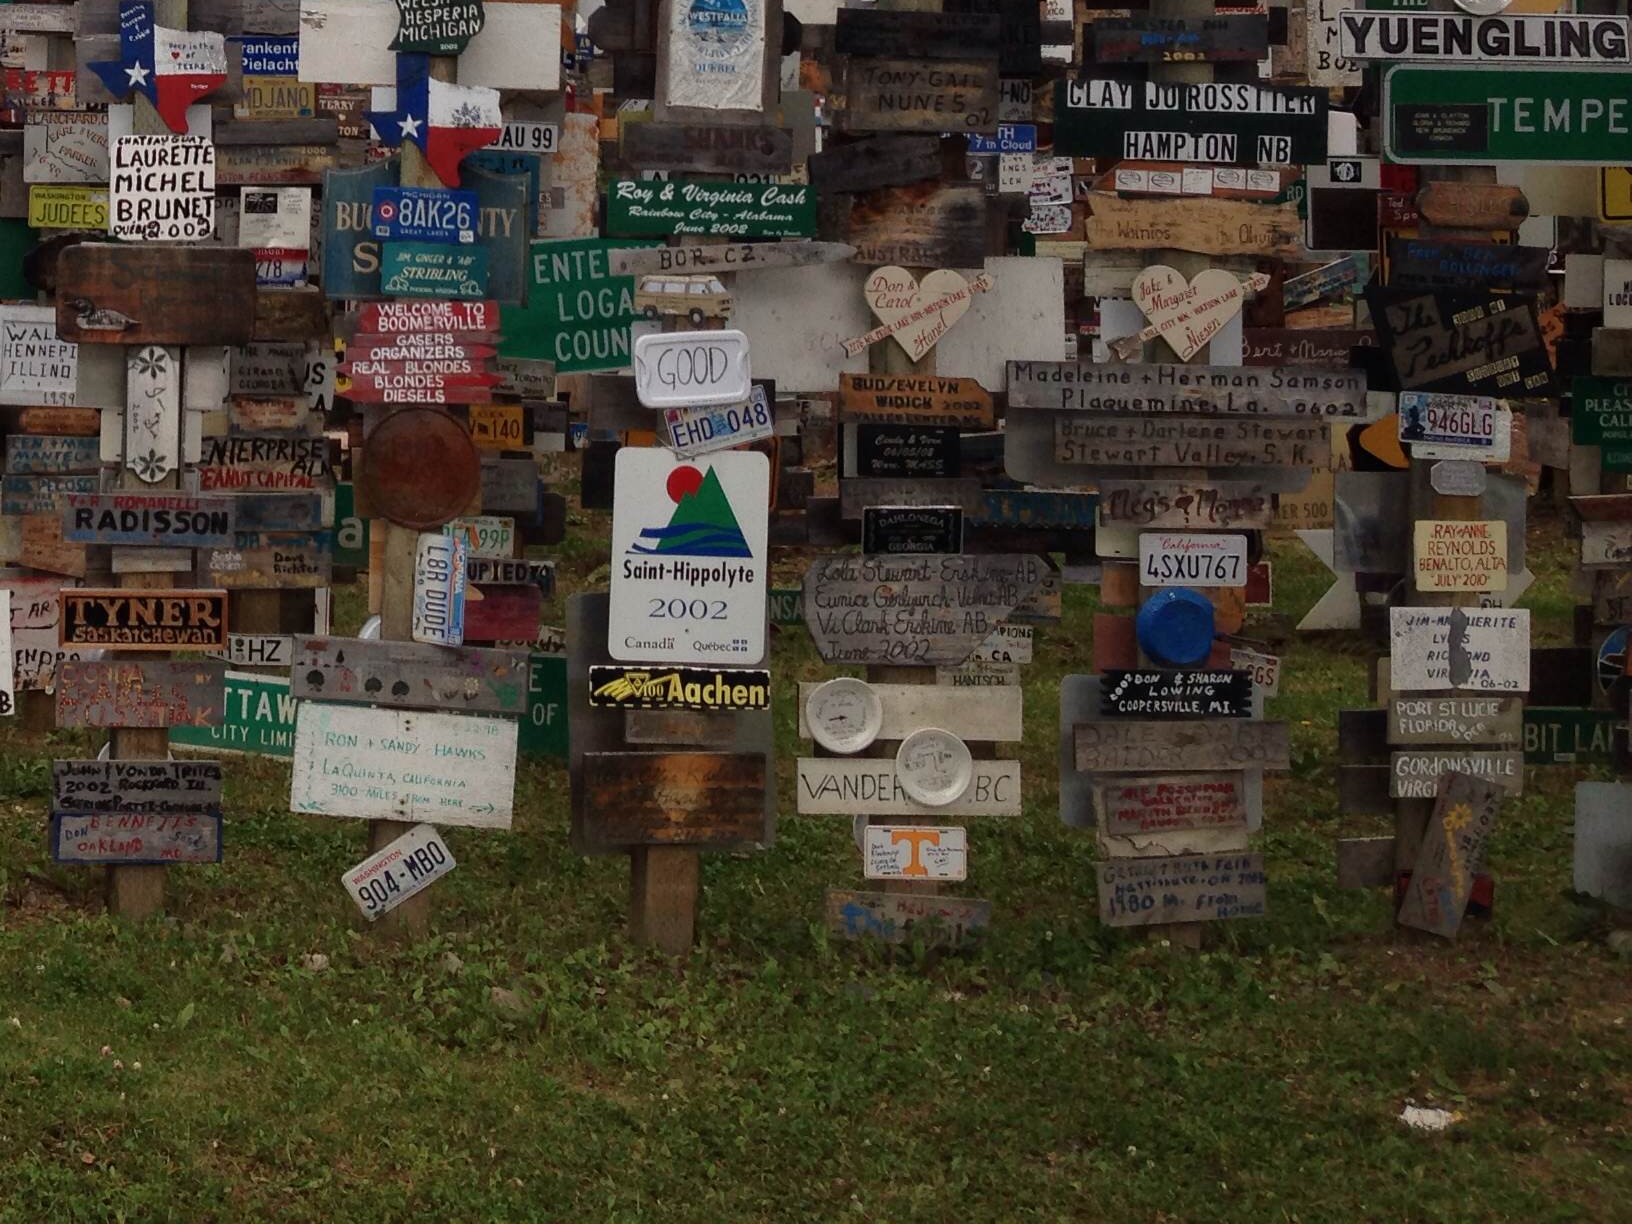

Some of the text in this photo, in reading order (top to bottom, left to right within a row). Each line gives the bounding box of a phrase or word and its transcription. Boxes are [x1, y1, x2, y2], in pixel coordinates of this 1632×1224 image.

[405, 5, 478, 25] HESPERIA
[398, 21, 481, 43] MICHIGAN
[1342, 15, 1626, 58] YUENGLING
[318, 99, 355, 111] TERRY
[1069, 81, 1132, 108] CLAY
[1487, 96, 1629, 134] TEMPE
[531, 126, 553, 148] 99
[1125, 133, 1290, 163] HAMPTON NB
[116, 144, 214, 167] LAURETTE
[115, 167, 215, 193] MICHEL
[681, 183, 806, 206] Virginia Cash
[117, 196, 215, 222] BRUNET
[399, 198, 470, 229] 8AK26
[377, 303, 486, 317] WELCOME TO
[378, 316, 487, 332] BOOMERVILLE
[396, 334, 455, 346] GASERS
[370, 346, 465, 360] ORGANIZERS
[352, 360, 472, 374] REAL BLONDES
[657, 346, 729, 391] GOOD
[1014, 364, 1359, 390] Madeleine Herman Samson
[374, 376, 445, 390] BLONDES
[383, 389, 446, 403] DIESELS
[673, 402, 770, 449] EHD 048
[1142, 421, 1328, 441] Darlene Stewart
[1426, 408, 1493, 437] 946GLG
[1061, 442, 1161, 462] Stewart
[75, 508, 229, 535] RADISSON
[1427, 539, 1497, 556] REYNOLDS
[622, 559, 755, 589] Saint-Hippolyte
[1146, 554, 1241, 579] 4SXU767
[68, 597, 221, 627] TYNER
[647, 597, 729, 621] 2002
[71, 626, 217, 645] Saskatchewan
[668, 674, 765, 706] Aachen
[1148, 685, 1216, 697] LOWING
[1396, 701, 1499, 718] PORT ST LUCIE
[323, 732, 487, 760] RON HAWKS
[1395, 756, 1515, 776] GORDONSVILLE
[890, 830, 941, 877] T
